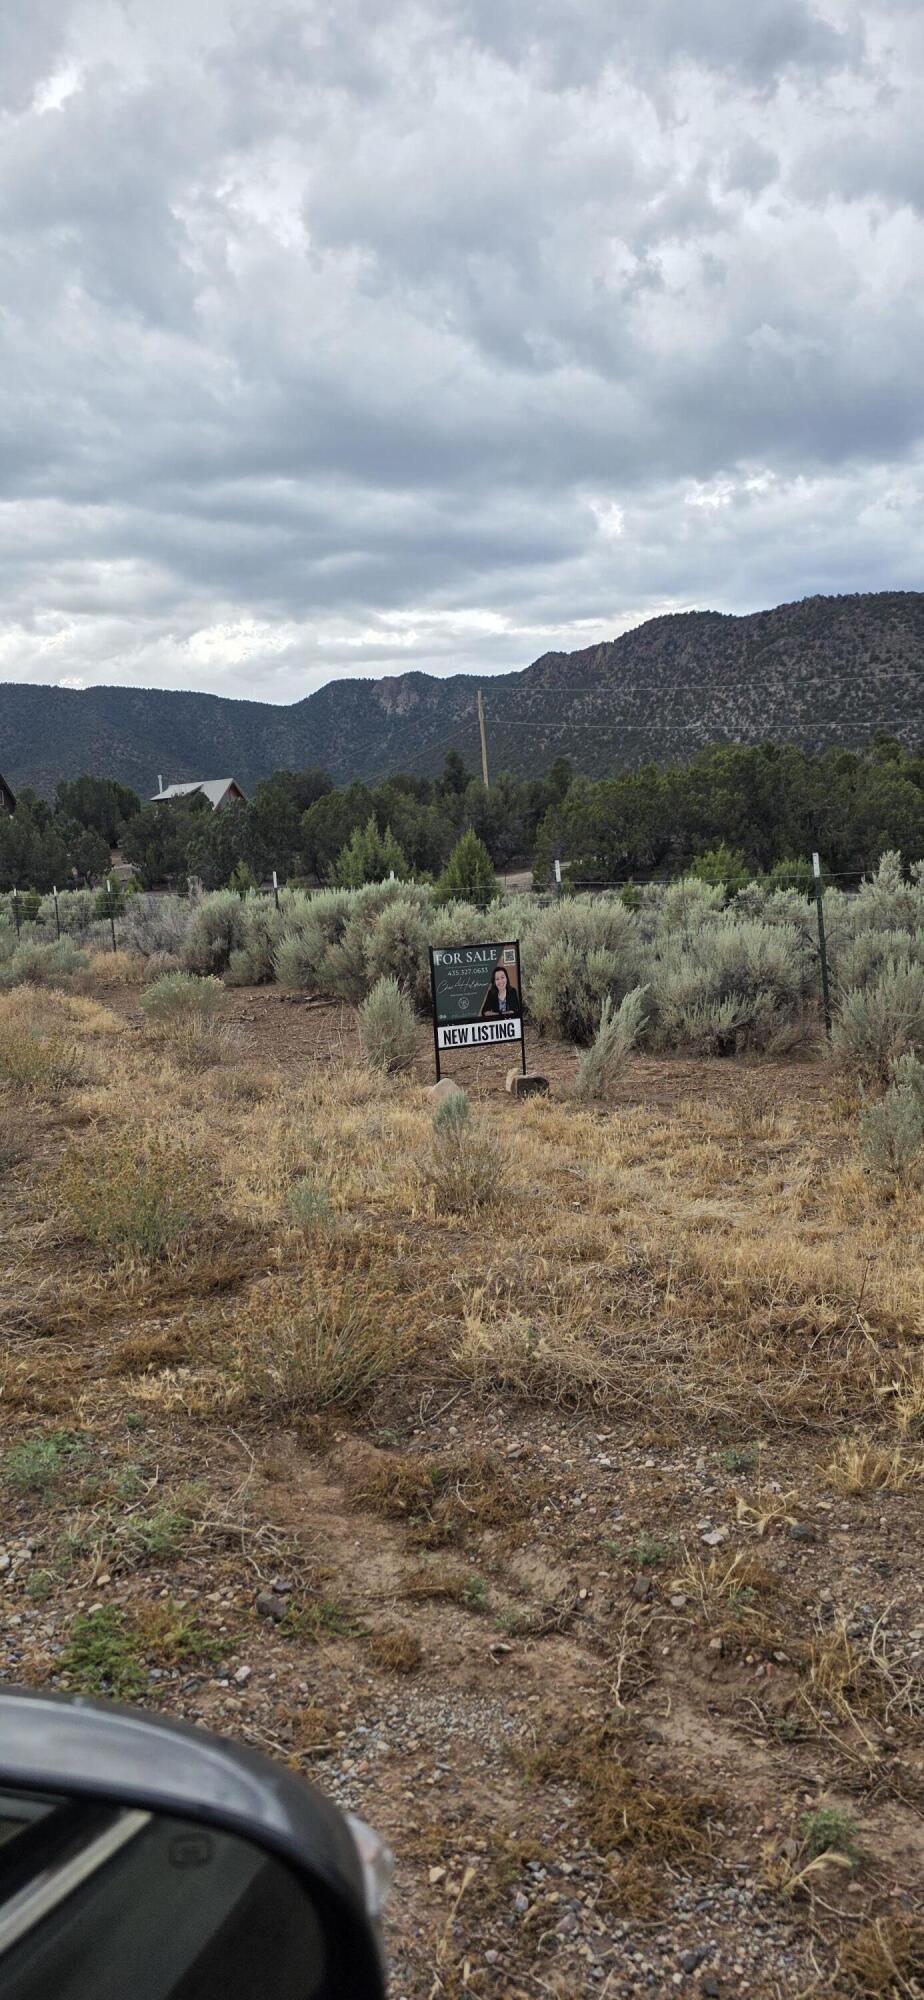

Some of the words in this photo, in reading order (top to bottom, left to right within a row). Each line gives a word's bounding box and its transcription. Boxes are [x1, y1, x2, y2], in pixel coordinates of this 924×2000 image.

[436, 952, 463, 966] FOR
[466, 949, 497, 963] SALE
[443, 1027, 469, 1046] NEW
[471, 1022, 515, 1042] LISTING
